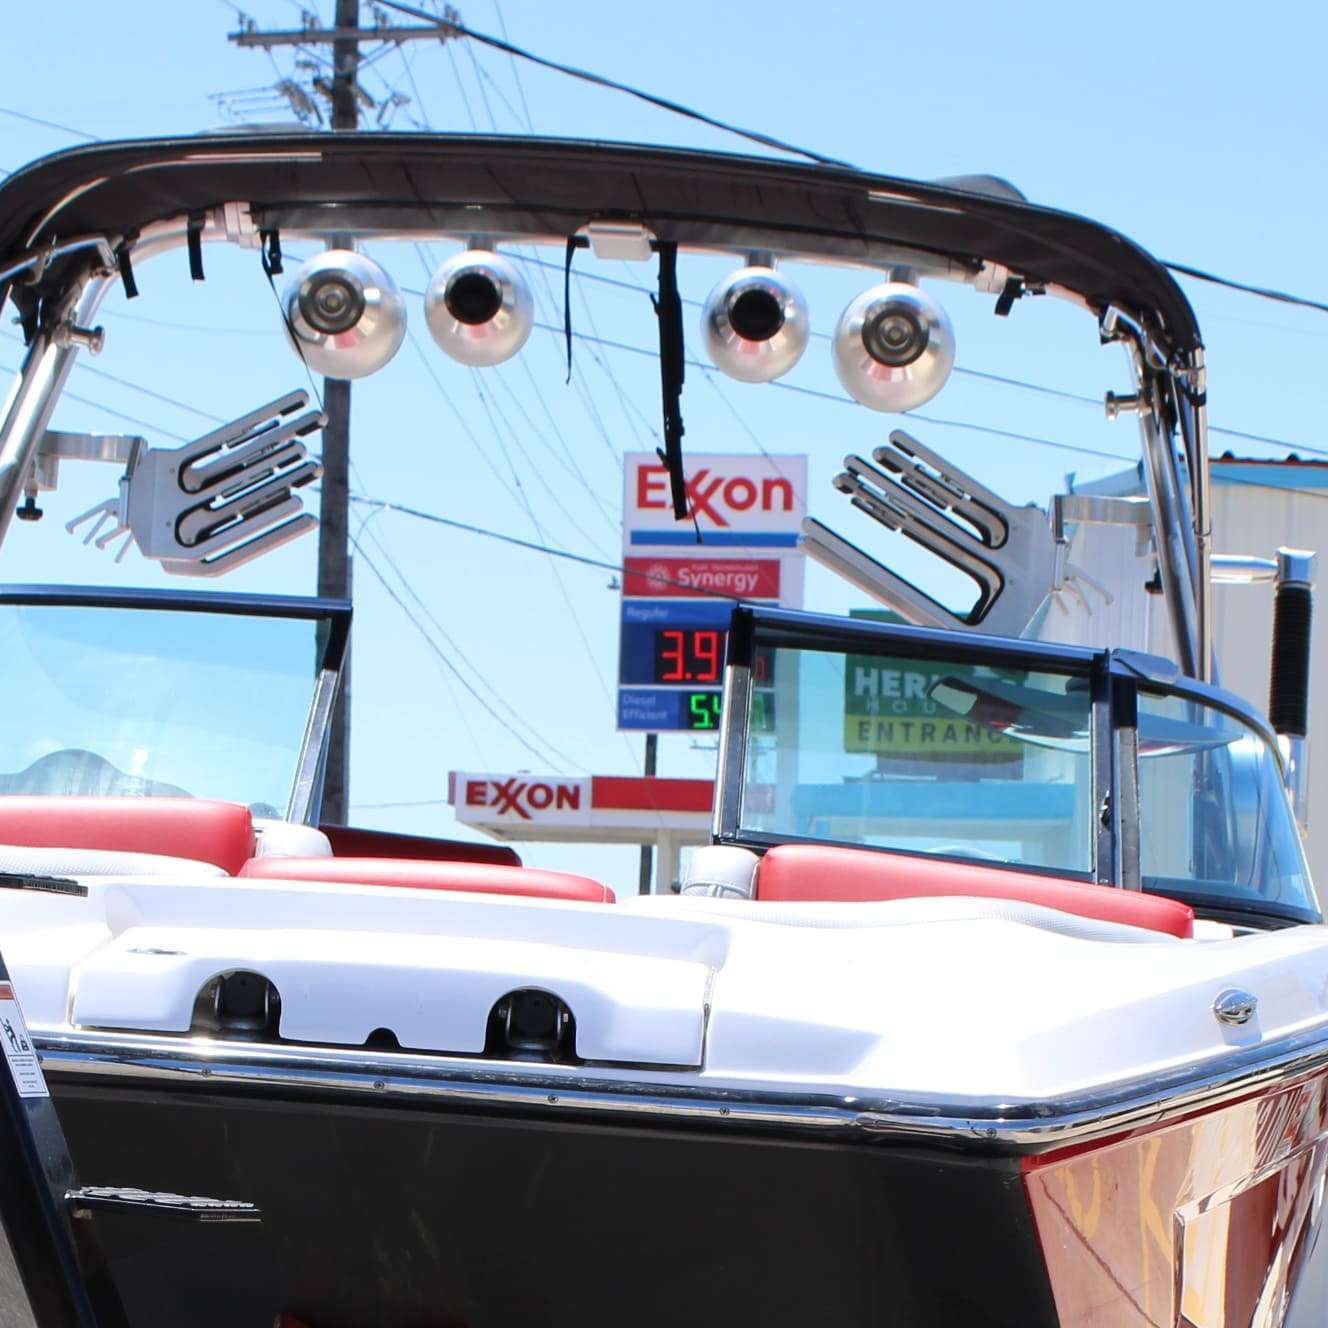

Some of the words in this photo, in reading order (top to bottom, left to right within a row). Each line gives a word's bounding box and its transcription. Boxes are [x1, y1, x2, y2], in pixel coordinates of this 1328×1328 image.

[677, 567, 759, 593] Synergy
[626, 607, 670, 621] Regular
[854, 666, 937, 699] HER
[465, 778, 581, 820] EXXON
